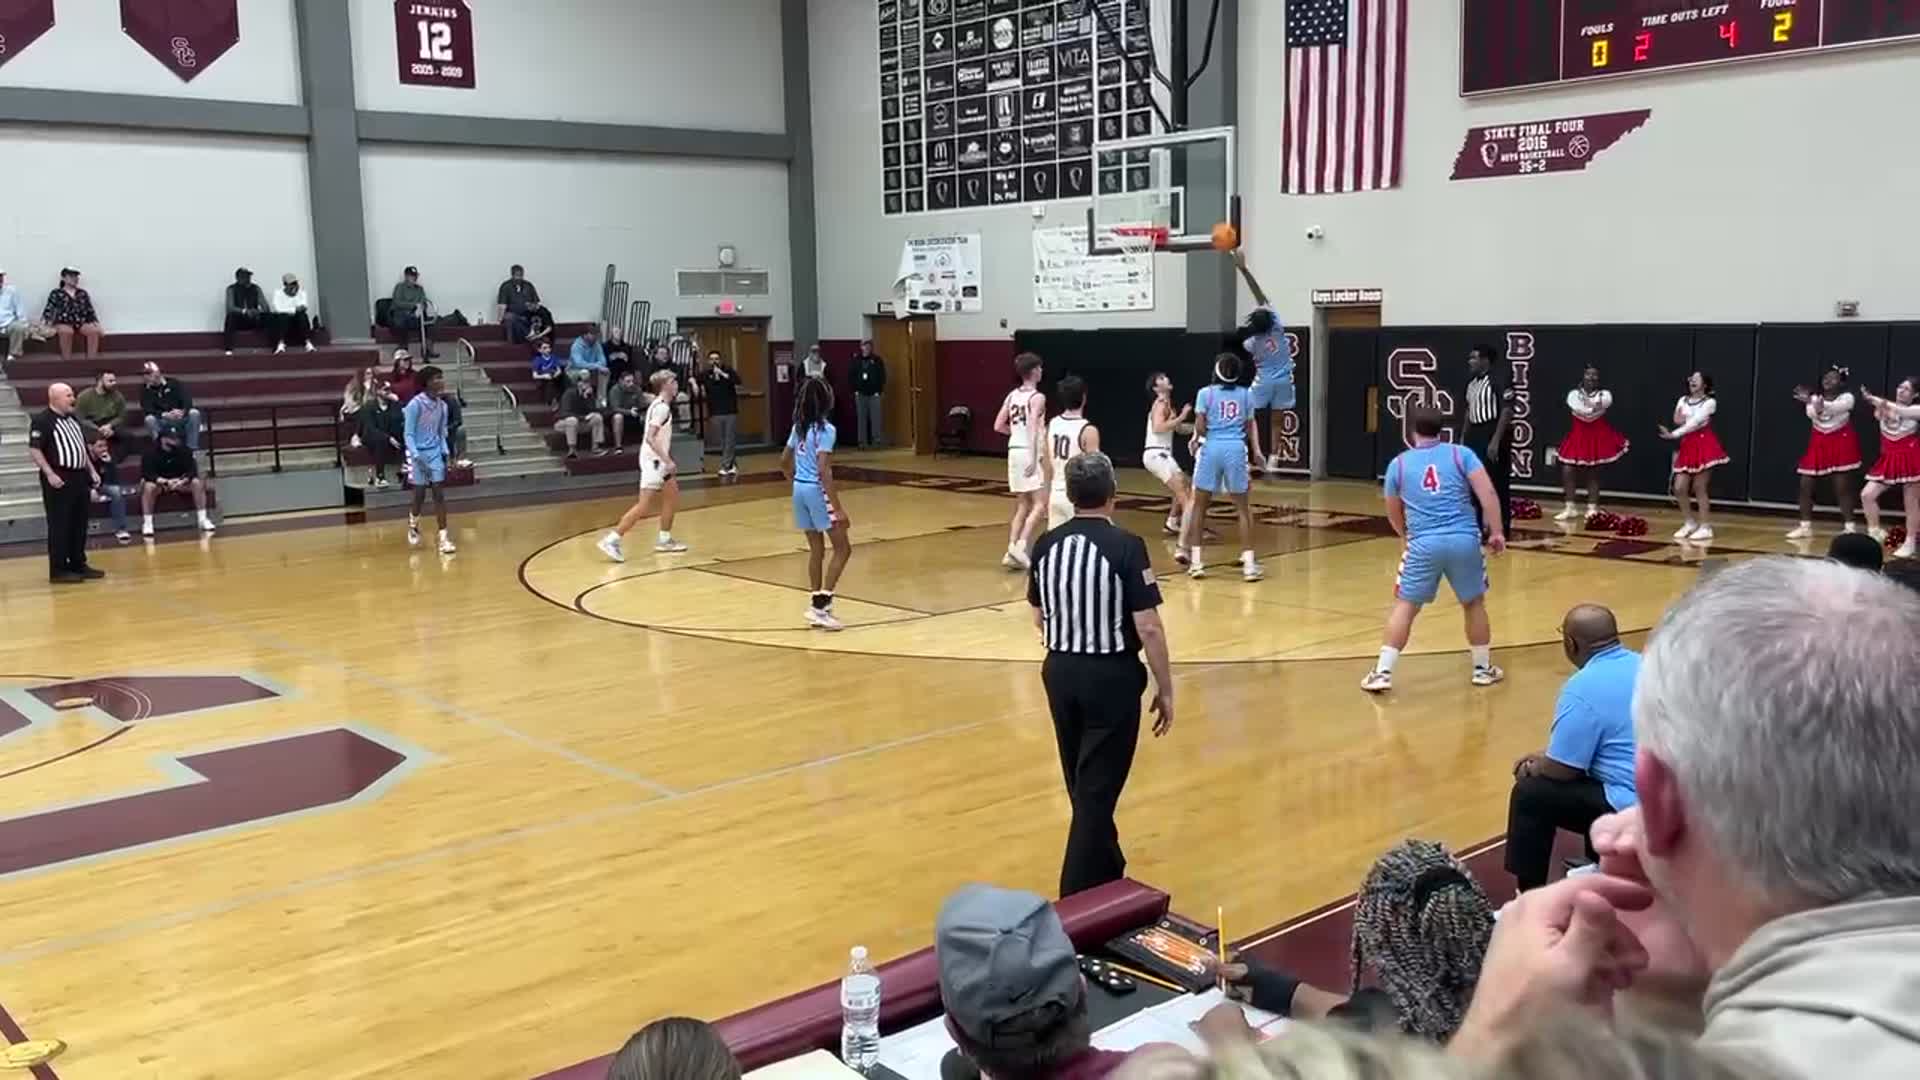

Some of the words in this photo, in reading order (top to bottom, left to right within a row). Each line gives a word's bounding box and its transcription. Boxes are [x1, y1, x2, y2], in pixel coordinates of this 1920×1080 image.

[409, 4, 457, 19] JENKINS
[1641, 13, 1668, 27] TIME
[1670, 9, 1699, 23] OUTS
[1701, 4, 1729, 17] LEFT
[417, 20, 454, 61] 12
[1580, 22, 1614, 37] FOULS
[1719, 21, 1736, 48] 4
[1773, 12, 1792, 42] 2
[171, 36, 196, 68] SC
[1059, 47, 1090, 67] VITA
[1591, 39, 1609, 67] 0
[1633, 33, 1650, 61] 2
[1483, 127, 1516, 141] STATE
[1518, 123, 1552, 137] FINAL
[1555, 119, 1585, 133] FOUR
[1517, 137, 1548, 152] 2016
[1519, 148, 1565, 161] BASKETBALL
[1332, 289, 1357, 302] Locker
[1359, 290, 1382, 302] Room
[1279, 332, 1301, 462] BON
[1506, 331, 1535, 478] BISON
[1053, 432, 1071, 460] 10
[1420, 464, 1441, 495] 4
